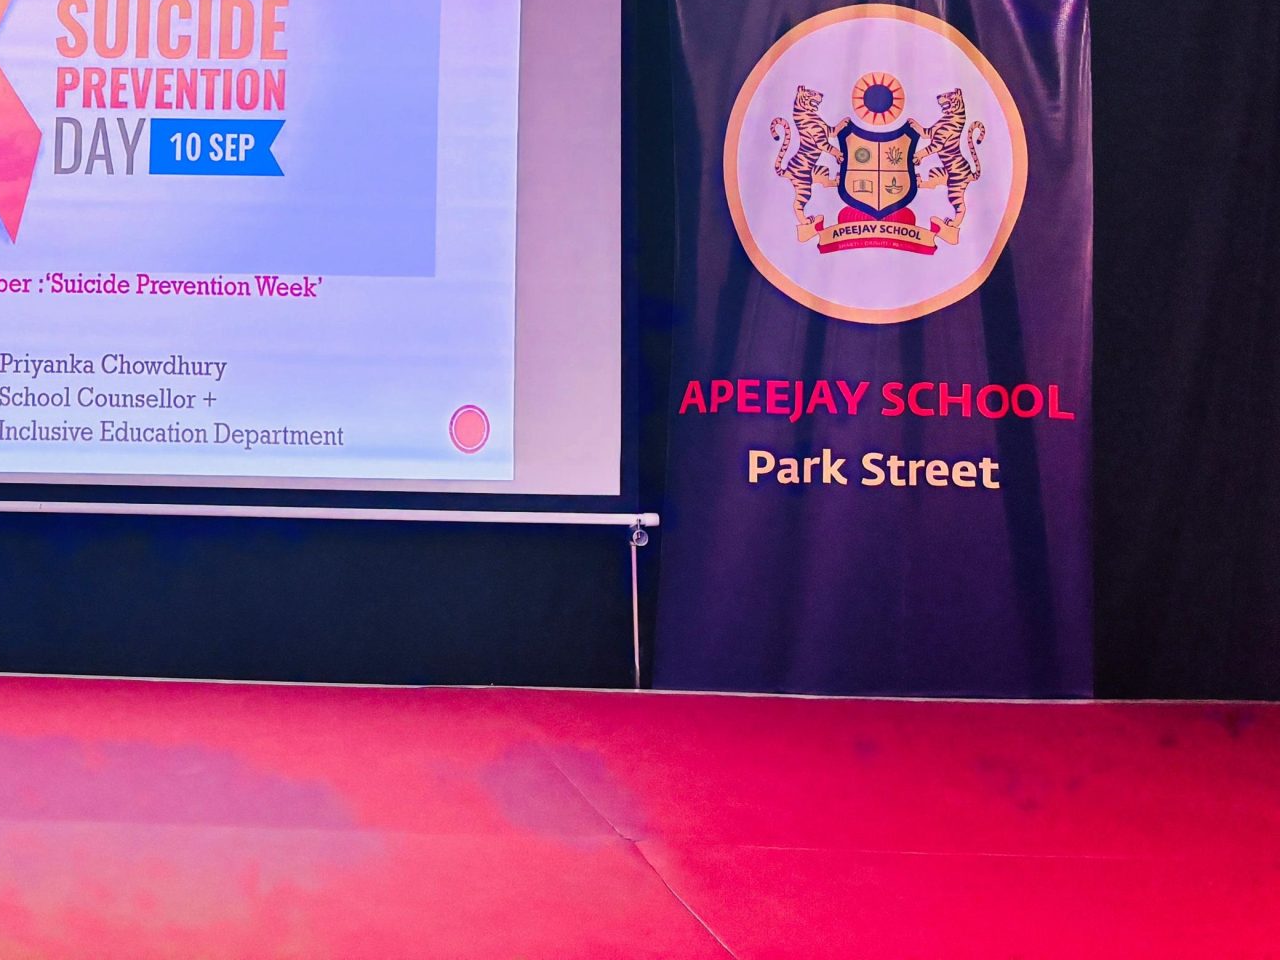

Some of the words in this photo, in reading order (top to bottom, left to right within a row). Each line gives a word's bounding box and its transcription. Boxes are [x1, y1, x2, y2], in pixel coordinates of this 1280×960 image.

[55, 67, 287, 111] PREVENTION
[53, 117, 146, 176] DAY
[169, 132, 202, 162] 10
[209, 132, 256, 162] SEP
[832, 224, 877, 239] APEEJAY
[879, 224, 922, 241] SCHOOL
[135, 274, 252, 297] Prevention
[0, 352, 95, 380] Priyanka
[100, 352, 228, 381] Chowdhury
[76, 386, 196, 410] Counsellor
[678, 379, 871, 423] APEEJAY
[880, 381, 1076, 422] SCHOOL
[99, 419, 208, 445] Education
[213, 421, 345, 451] Department
[747, 449, 848, 485] Park
[860, 451, 1001, 490] Street
